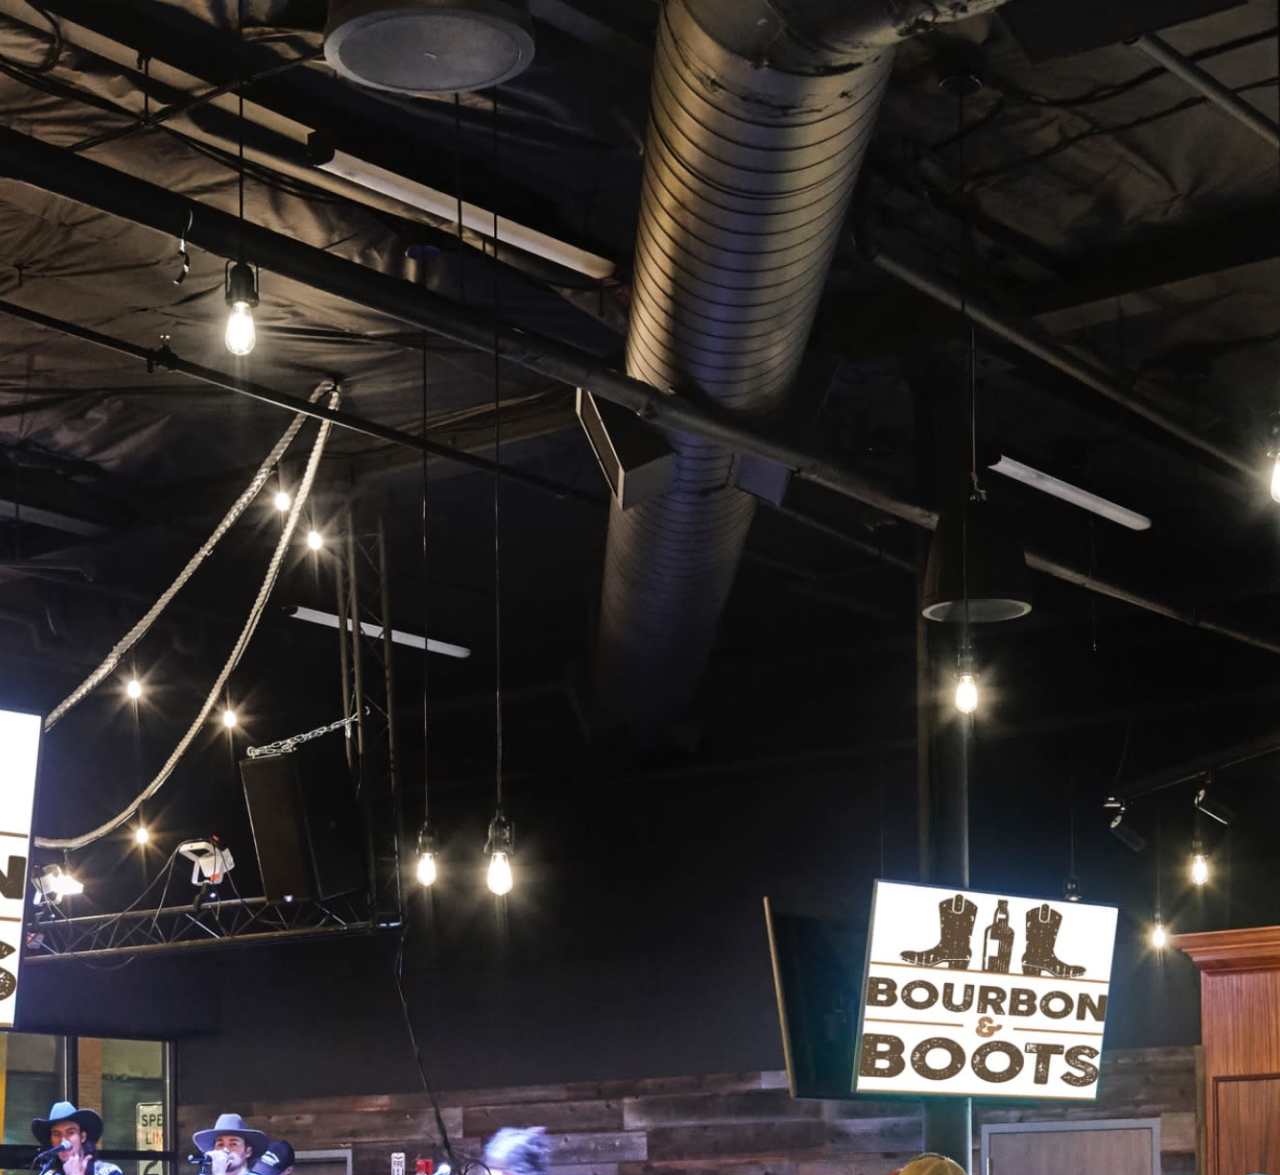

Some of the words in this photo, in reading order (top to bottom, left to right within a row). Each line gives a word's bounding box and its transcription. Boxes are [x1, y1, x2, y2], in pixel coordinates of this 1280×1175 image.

[865, 976, 1109, 1022] BOURBON
[975, 1016, 1003, 1038] &
[858, 1033, 1100, 1087] BOOTS
[141, 1114, 163, 1127] SPE
